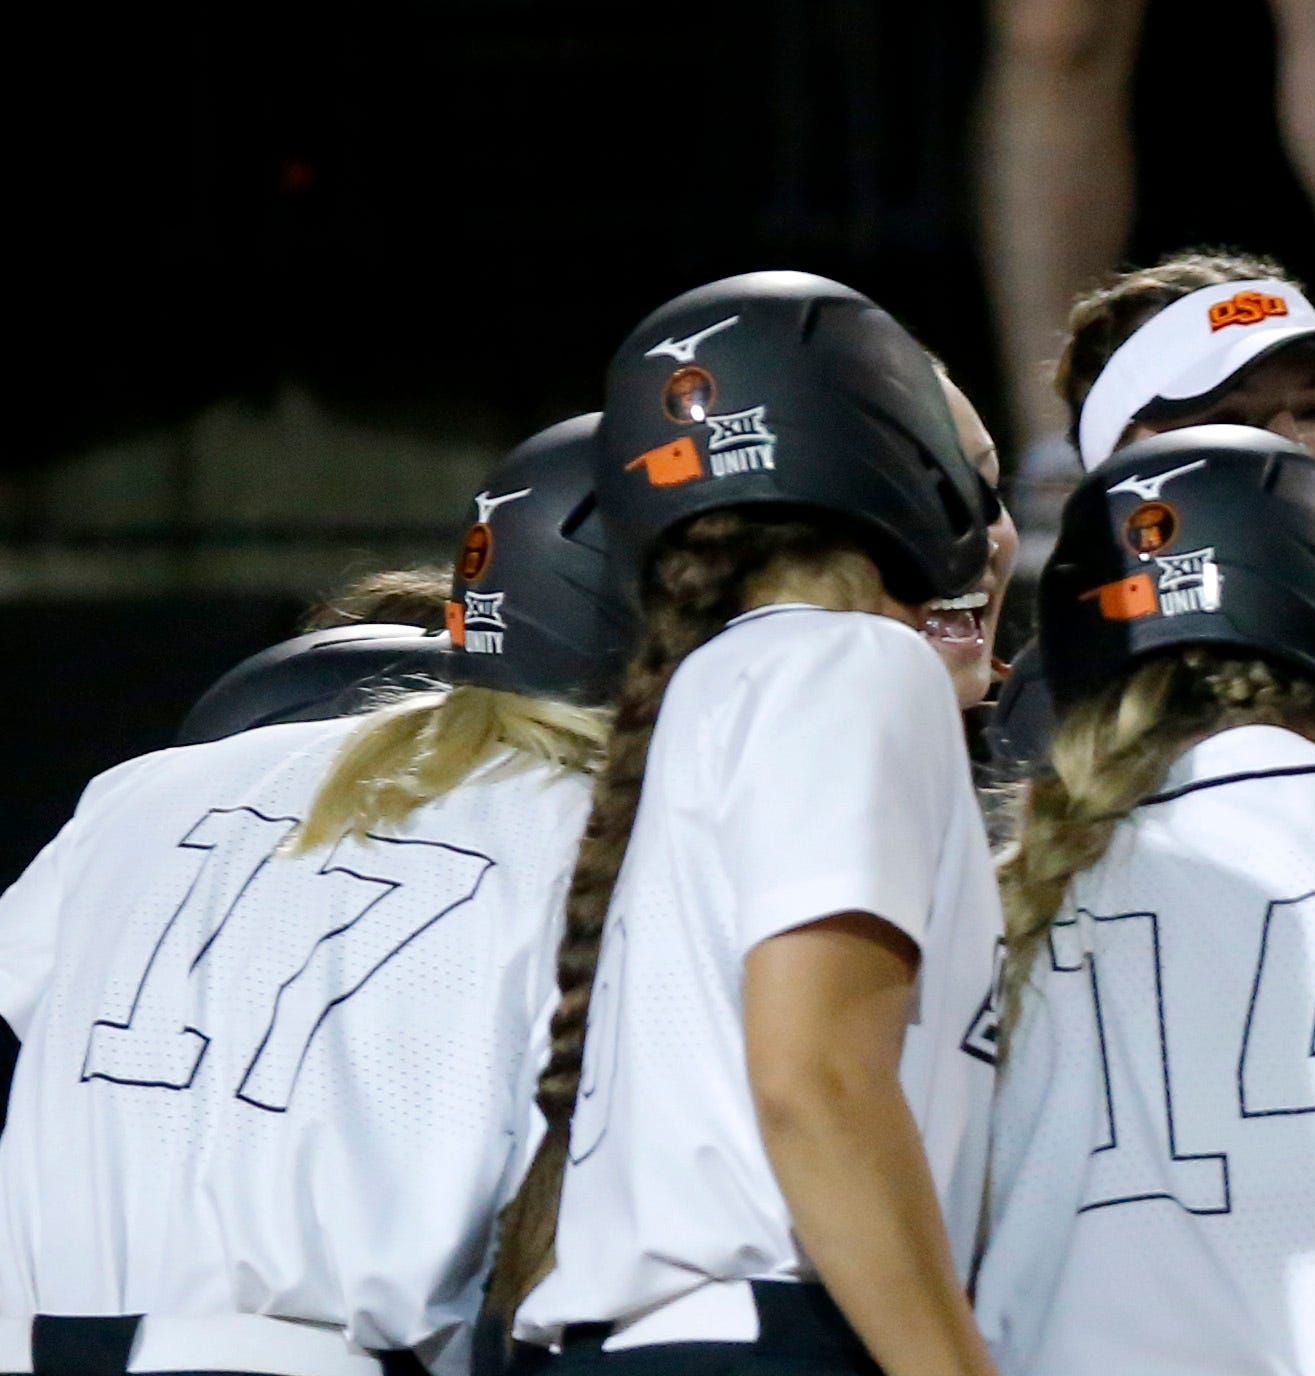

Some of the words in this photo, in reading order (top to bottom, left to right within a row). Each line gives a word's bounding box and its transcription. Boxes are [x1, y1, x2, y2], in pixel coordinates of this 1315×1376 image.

[1208, 290, 1289, 333] OSU
[709, 443, 776, 477] UNITY
[1160, 586, 1222, 616] UNIT
[81, 805, 497, 1112] 17
